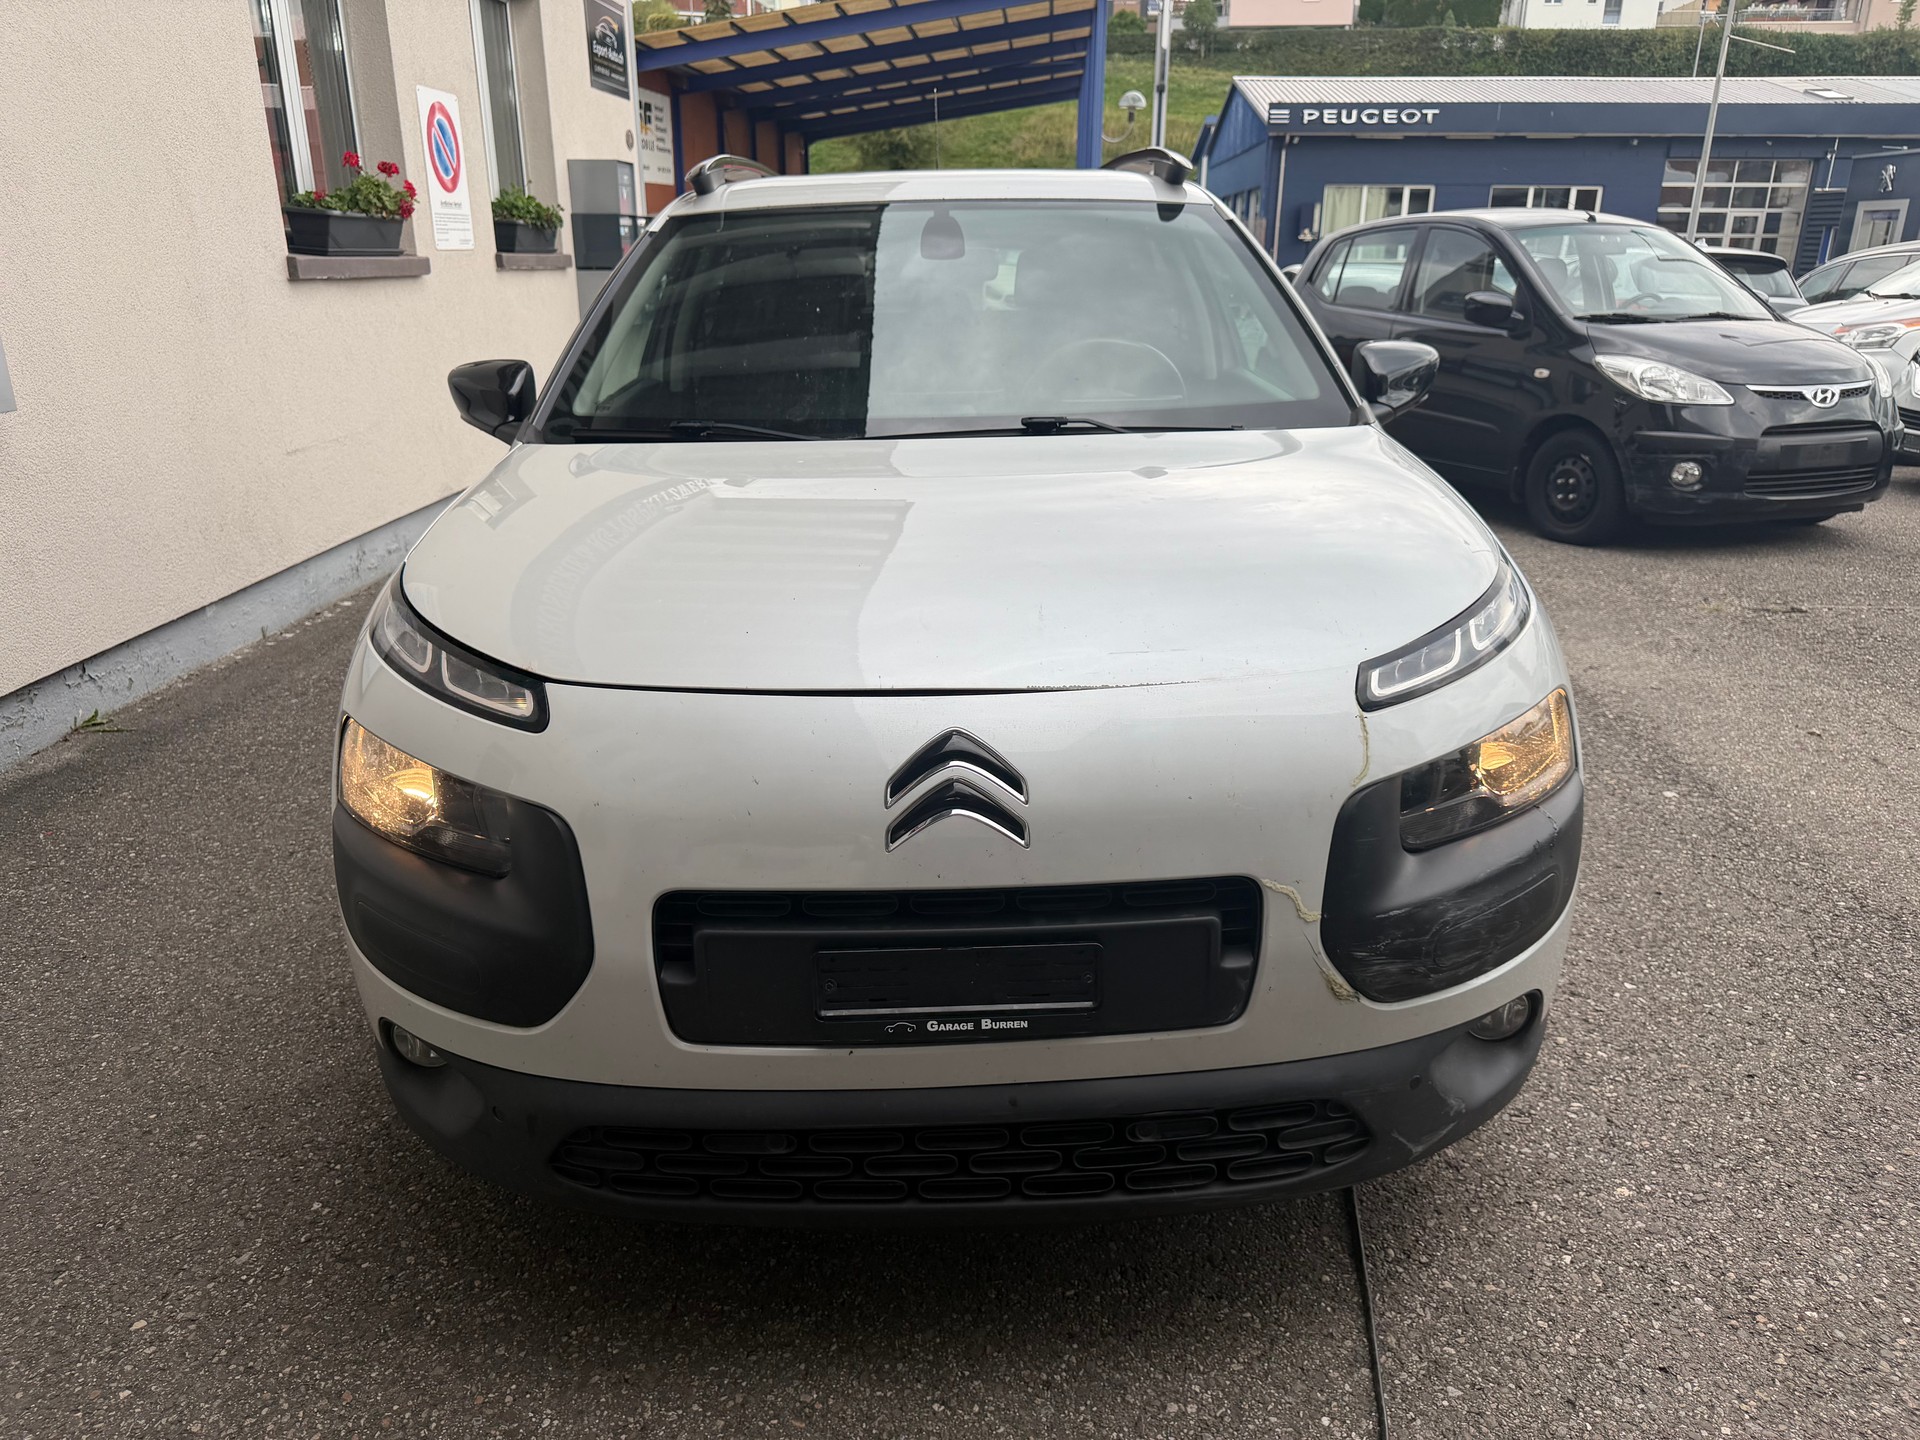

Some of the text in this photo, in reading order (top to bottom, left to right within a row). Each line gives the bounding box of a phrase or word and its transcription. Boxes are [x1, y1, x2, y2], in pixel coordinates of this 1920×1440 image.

[1303, 108, 1440, 125] PEUGEOT
[926, 1018, 1028, 1032] GARAGE BURREN
